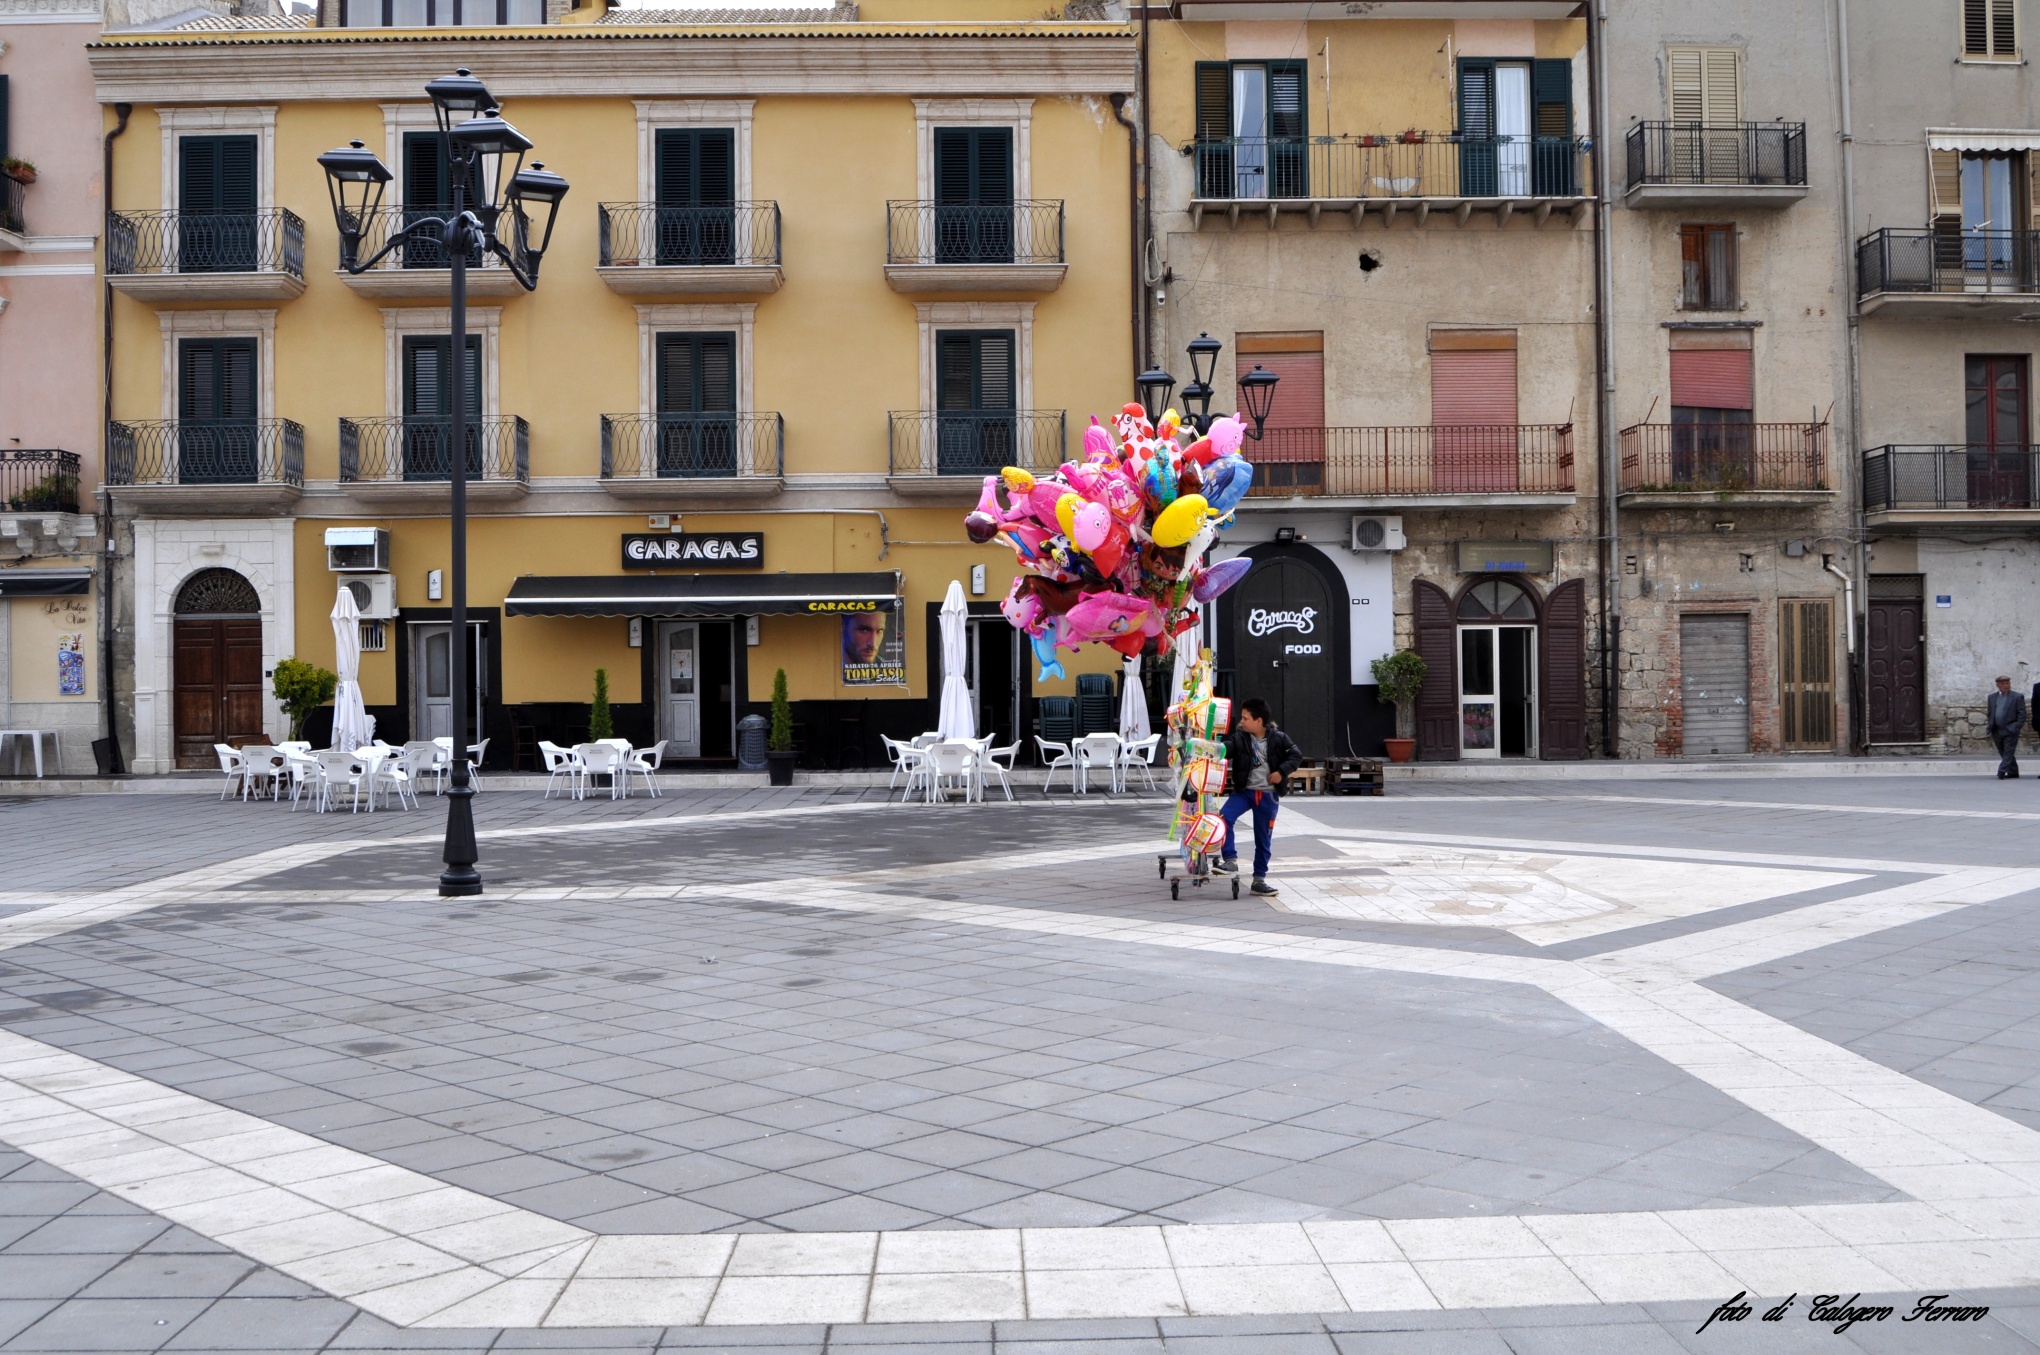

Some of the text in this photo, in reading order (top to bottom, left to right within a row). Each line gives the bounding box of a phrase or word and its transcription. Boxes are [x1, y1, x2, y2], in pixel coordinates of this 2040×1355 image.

[626, 537, 759, 560] CARACAS
[44, 599, 88, 615] La Dolce
[808, 601, 877, 612] CARACAS
[66, 612, 86, 625] Vita
[1285, 644, 1322, 655] FOOD
[845, 668, 904, 680] TOMMASO
